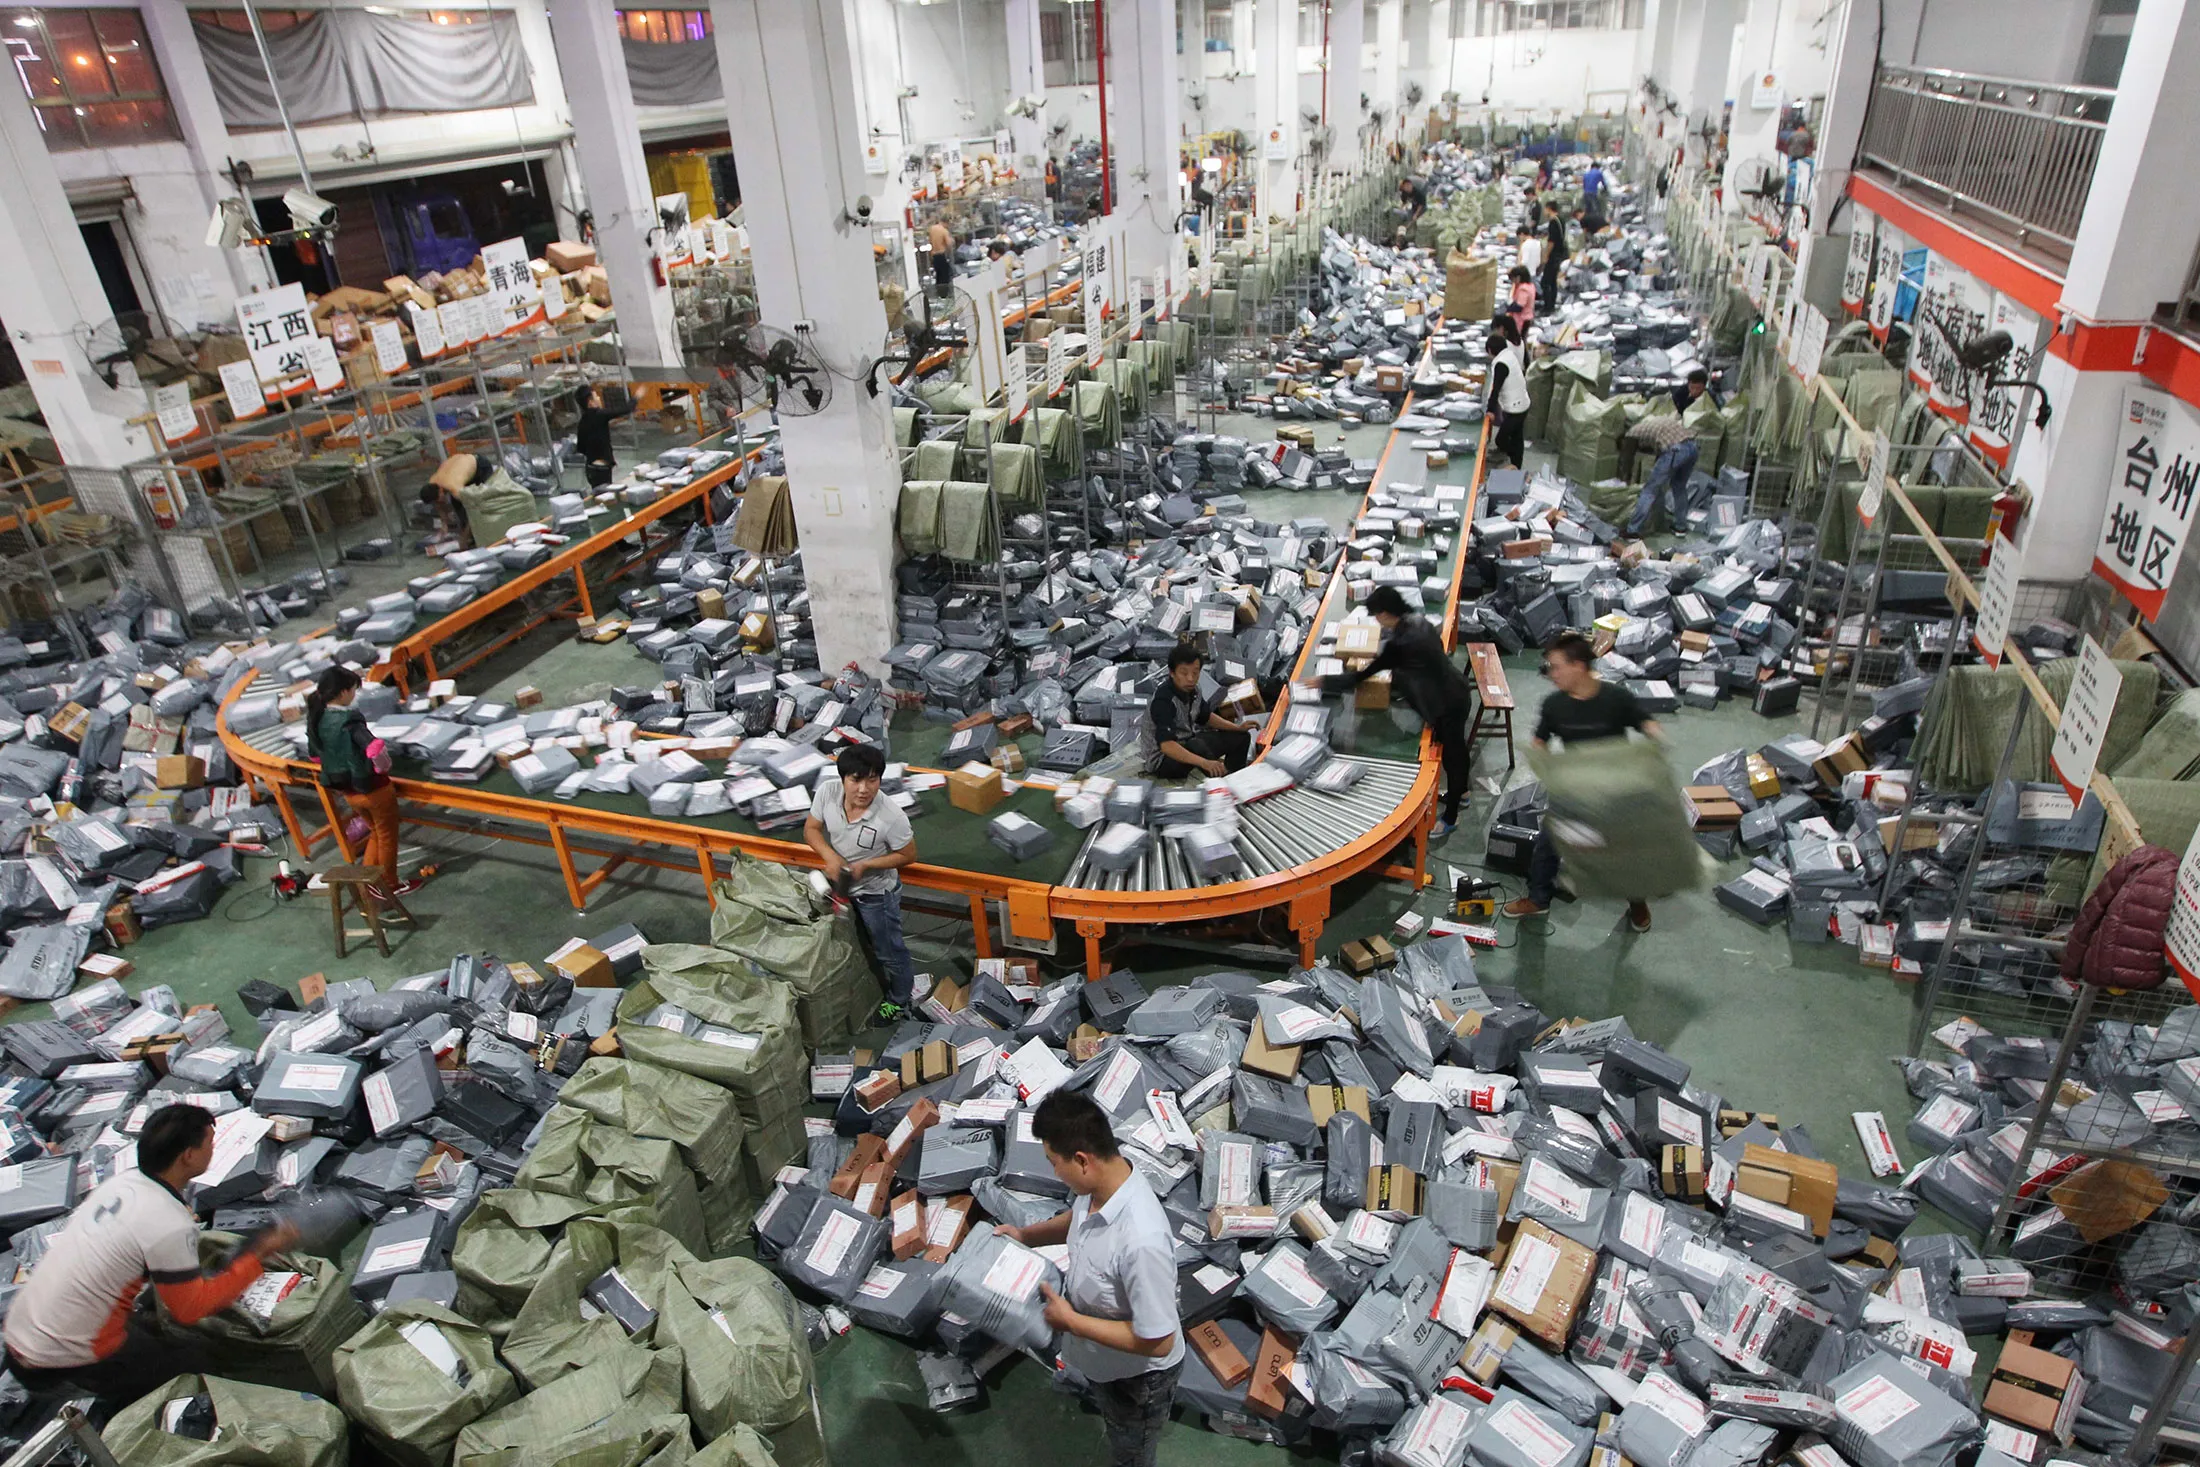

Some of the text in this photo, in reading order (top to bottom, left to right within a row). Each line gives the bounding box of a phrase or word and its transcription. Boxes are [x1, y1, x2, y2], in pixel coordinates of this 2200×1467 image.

[490, 260, 530, 291] 青海
[510, 294, 529, 320] 省
[248, 309, 310, 351] 江西
[279, 352, 308, 382] 省
[1977, 389, 2017, 444] 地区
[2123, 435, 2200, 521] 台州
[2105, 501, 2177, 590] 地区
[971, 1128, 993, 1143] STO
[1413, 1323, 1428, 1342] STO
